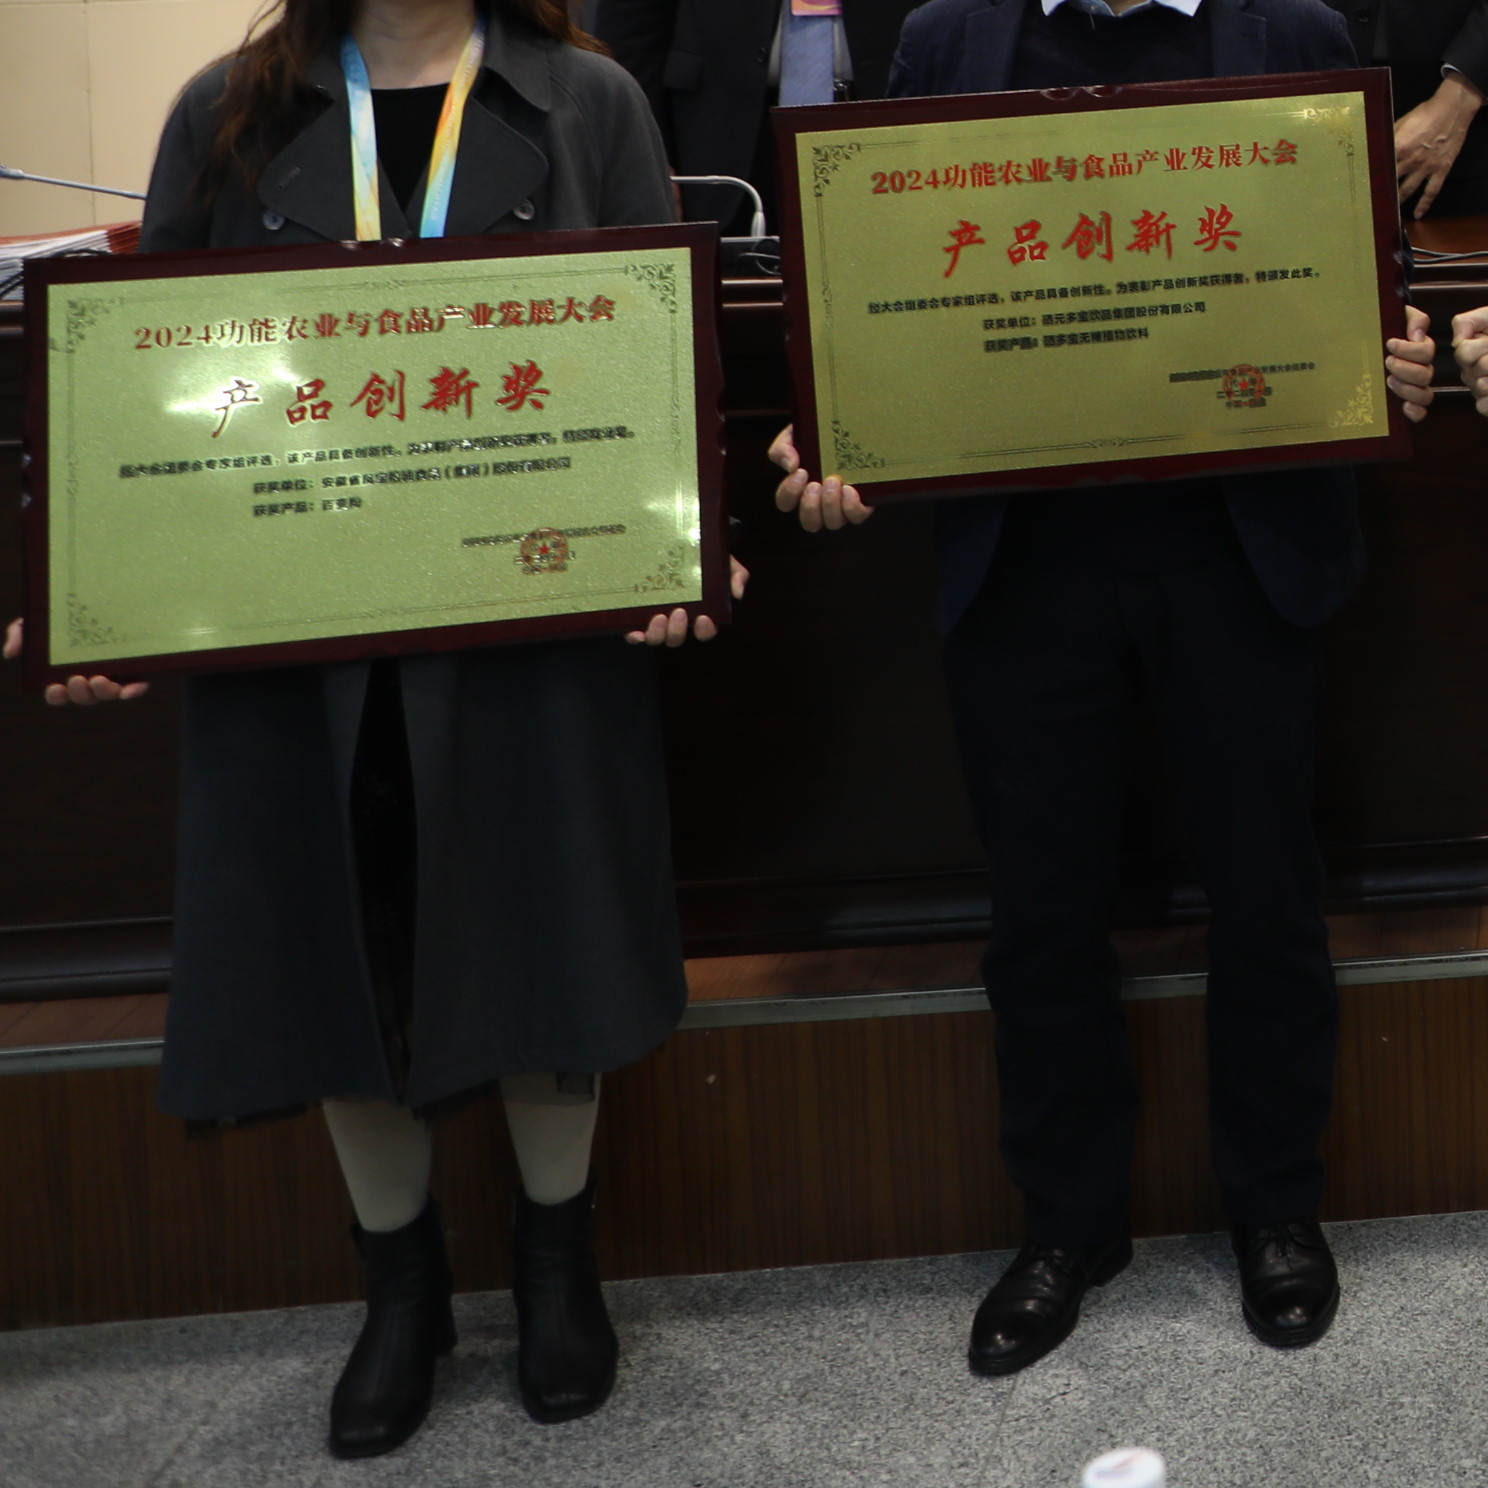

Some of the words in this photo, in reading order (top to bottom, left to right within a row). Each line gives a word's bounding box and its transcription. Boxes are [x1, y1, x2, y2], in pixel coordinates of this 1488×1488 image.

[871, 138, 1299, 195] 2024功能农业与食品产业发展大会
[942, 203, 1242, 278] 产品创新奖
[133, 294, 616, 350] 2024功能农业与食品产业发展大会
[211, 359, 550, 439] 产品创新奖
